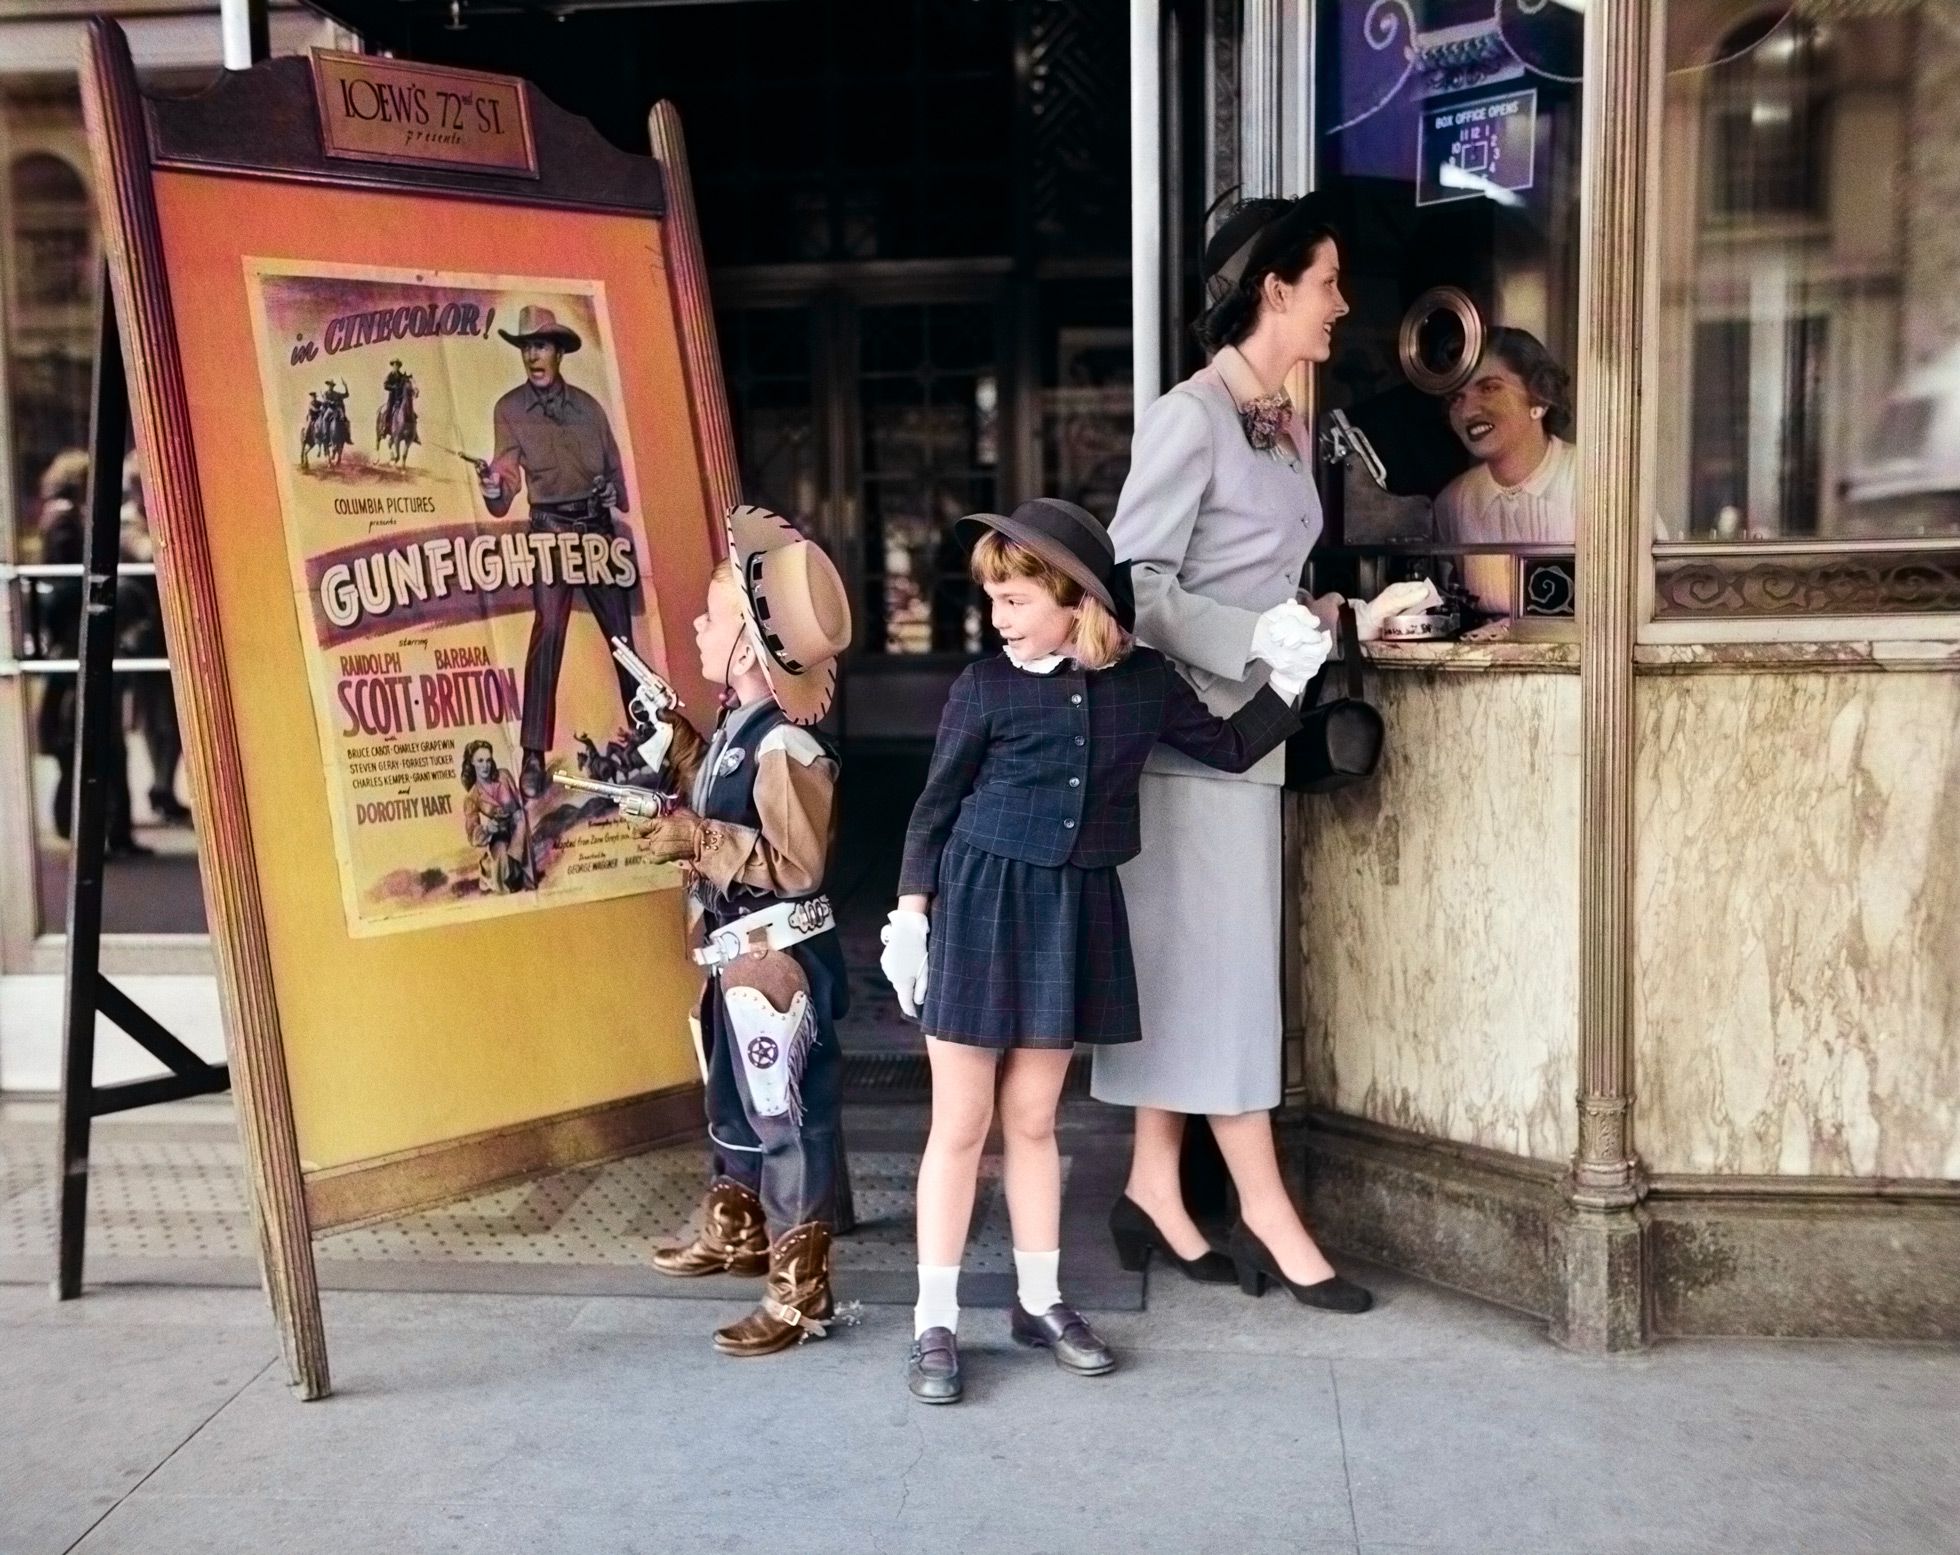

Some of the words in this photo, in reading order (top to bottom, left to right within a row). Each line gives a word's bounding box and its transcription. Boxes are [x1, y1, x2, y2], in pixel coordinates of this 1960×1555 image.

[339, 78, 430, 125] LOEW'S
[1435, 115, 1453, 129] BOX
[1455, 107, 1486, 125] OFFICE
[1488, 101, 1519, 118] OPENS
[405, 129, 461, 146] presents
[1460, 129, 1469, 141] 11
[1471, 127, 1480, 139] 12
[1490, 134, 1498, 147] 2
[1451, 142, 1461, 155] 10
[1493, 147, 1500, 160] 3
[1489, 161, 1496, 174] 4
[290, 333, 319, 366] in
[324, 302, 495, 355] CINECOLOR!
[334, 498, 385, 515] COLUMBIA
[386, 497, 436, 514] PICTURES
[368, 518, 397, 534] presents
[320, 532, 637, 627] GUNFIGHTERS
[399, 638, 429, 650] starring
[340, 652, 402, 676] RANDOLPH
[434, 646, 491, 670] BARBARA
[337, 675, 416, 737] SCOTT
[419, 668, 522, 730] BRITTON
[347, 748, 369, 760] BRUCE
[371, 745, 391, 757] CABOT
[393, 743, 420, 754] CHARLEY
[420, 740, 455, 753] GRAPEWIN
[350, 763, 377, 775] STEVEN
[378, 761, 400, 771] GERAY
[402, 757, 429, 769] FORREST
[430, 755, 454, 765] TUCKER
[352, 778, 384, 790] CHARLES
[384, 774, 411, 785] KEMPER
[412, 771, 430, 783] GRANT
[431, 769, 457, 780] WITHERS
[356, 797, 418, 825] DOROTHY
[420, 794, 453, 817] HART
